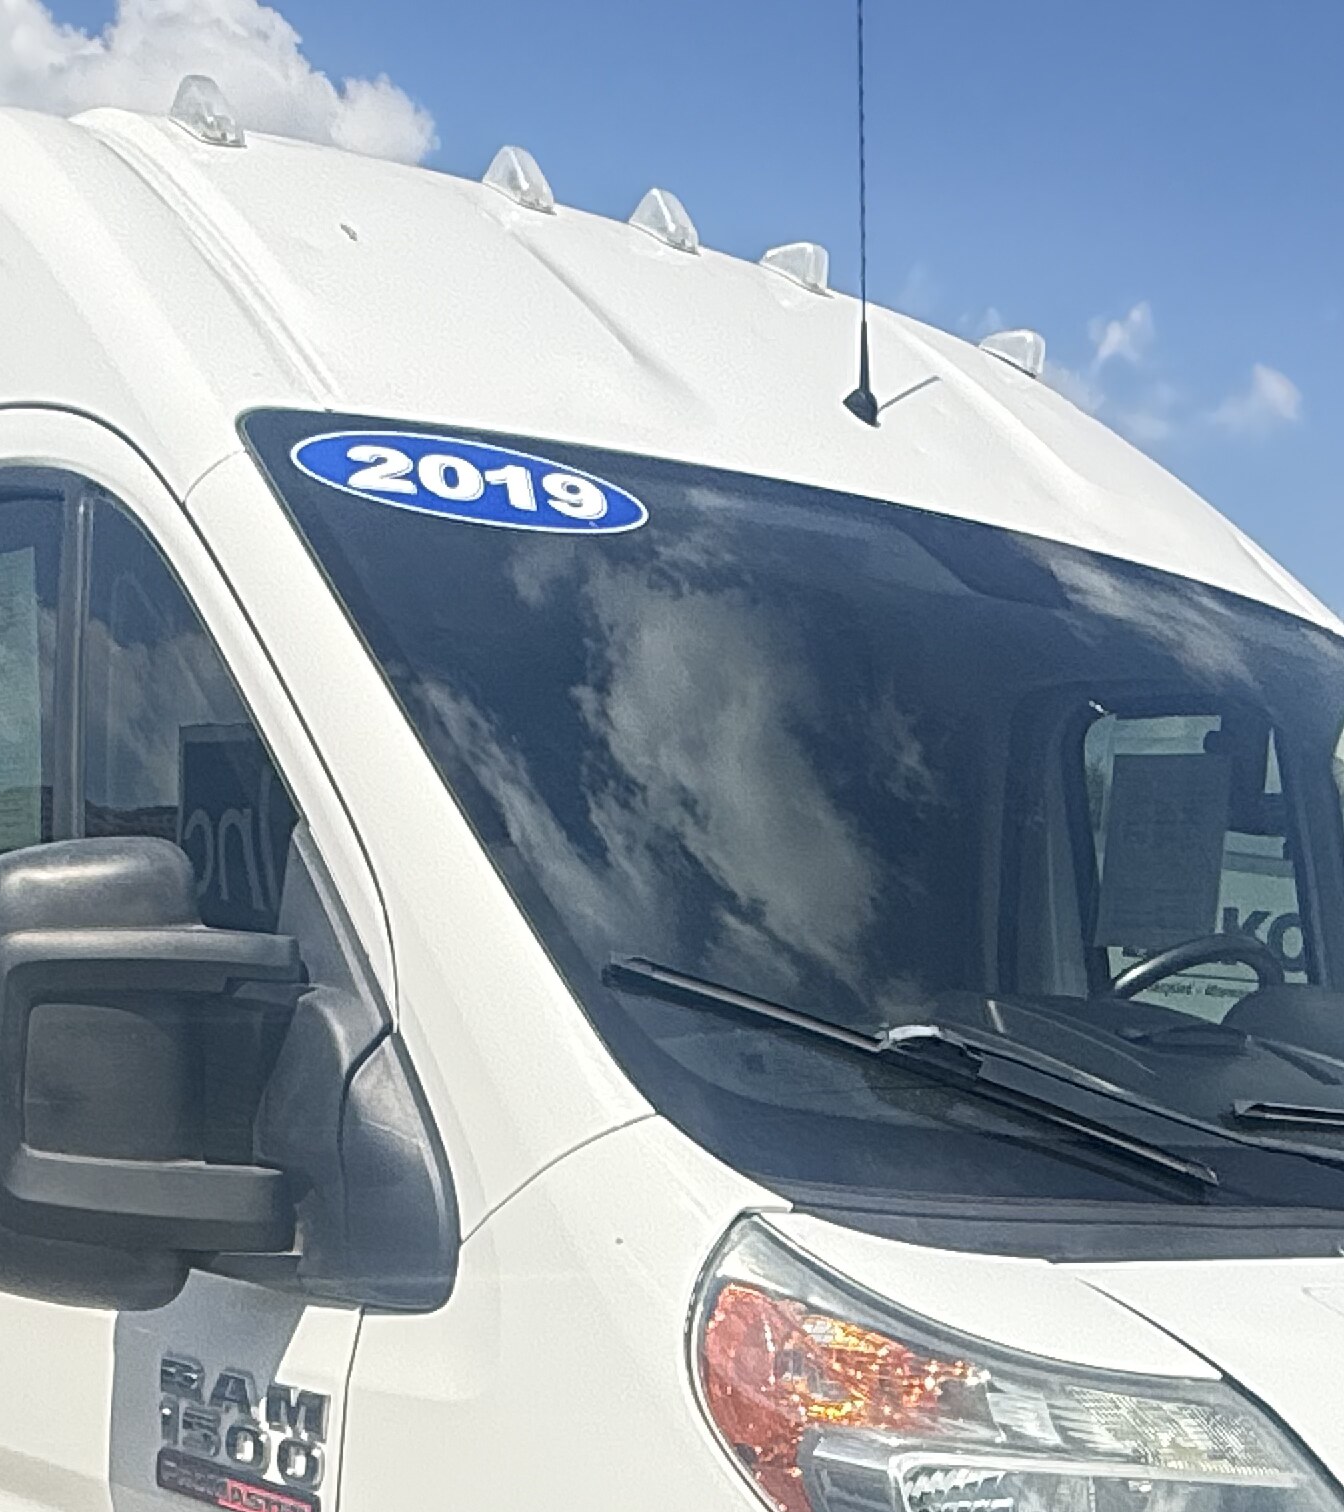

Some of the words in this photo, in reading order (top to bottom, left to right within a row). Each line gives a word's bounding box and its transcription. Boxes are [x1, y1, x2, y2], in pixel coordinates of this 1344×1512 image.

[346, 444, 608, 520] 2019
[159, 1398, 325, 1491] 1500
[160, 1355, 331, 1445] RAM
